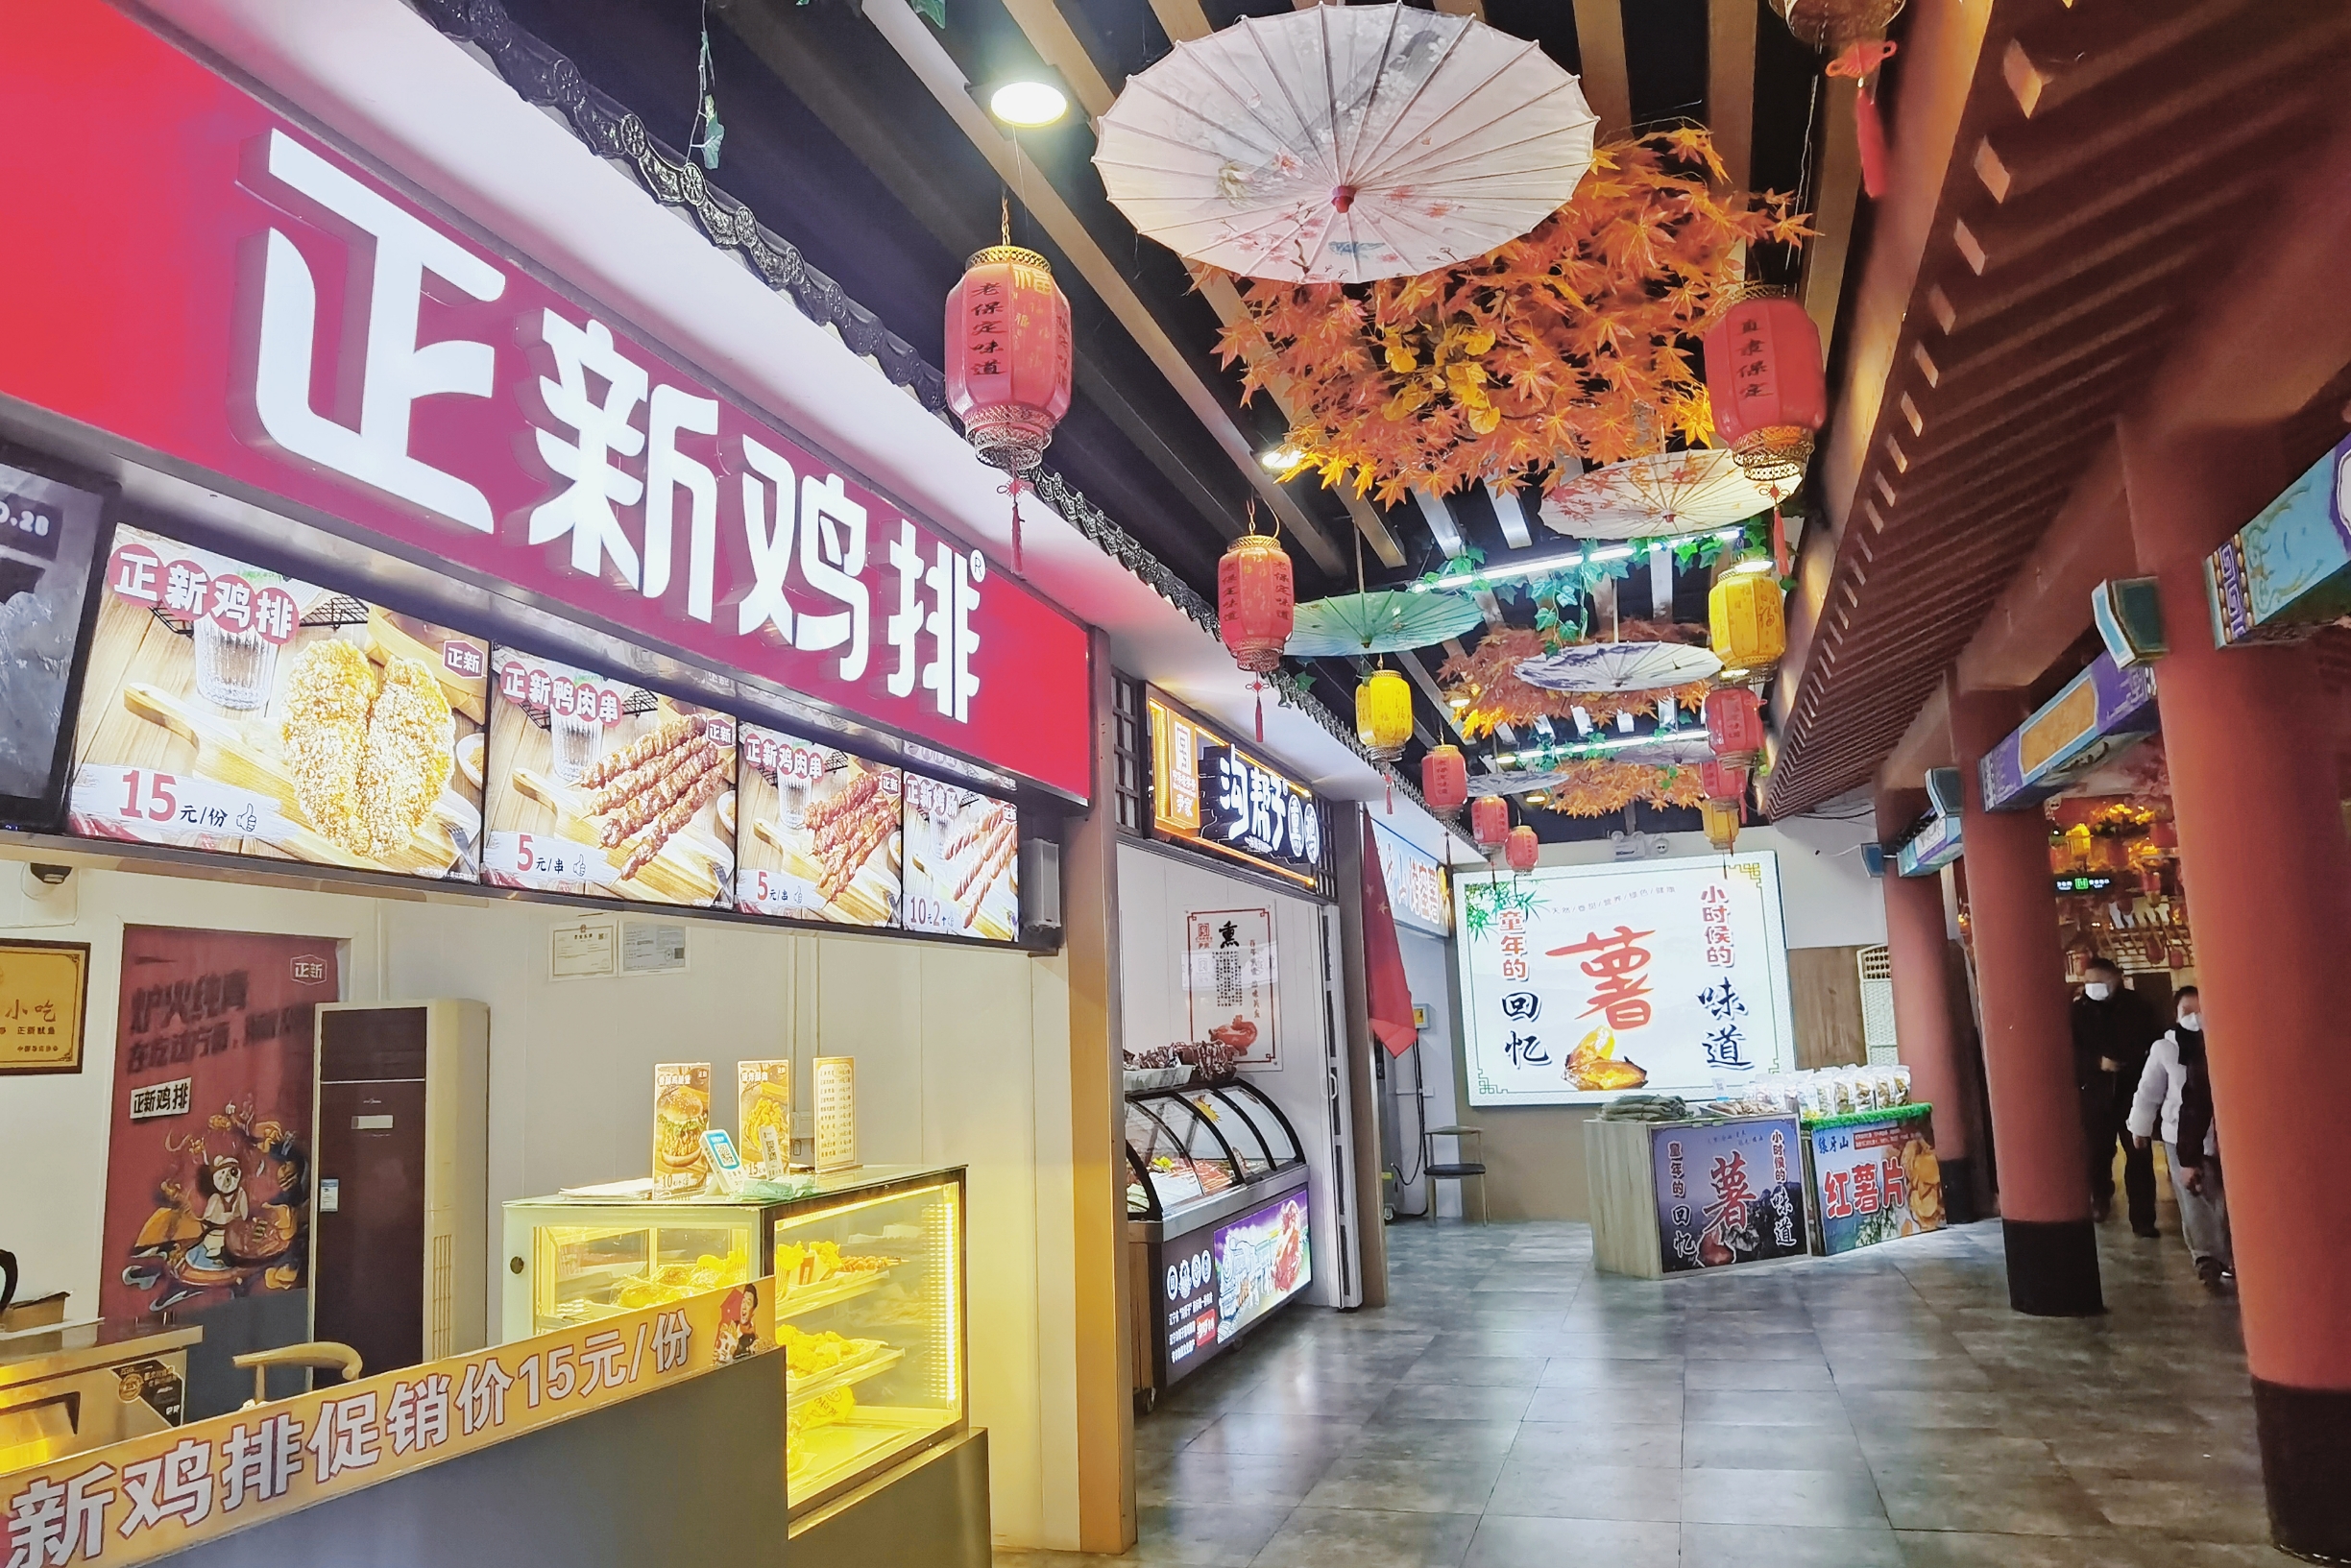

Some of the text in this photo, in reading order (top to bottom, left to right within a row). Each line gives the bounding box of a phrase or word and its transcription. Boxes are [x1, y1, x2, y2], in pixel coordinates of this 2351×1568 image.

[970, 282, 1006, 375] 老保定味道
[256, 128, 981, 724] 正新鸡排
[114, 549, 294, 639] 正新鸡排
[447, 646, 480, 675] 正新
[501, 666, 619, 725] 正新鸭肉串
[709, 724, 732, 743] 正新
[745, 737, 823, 780] 正新鸡肉串
[118, 770, 229, 828] 15元/份
[882, 774, 899, 793] 正新
[906, 778, 958, 816] 正新烤肠
[1220, 743, 1287, 852] 沟帮子
[517, 833, 564, 875] 5元/串
[294, 962, 323, 979] 正新
[1498, 910, 1550, 1066] 童年的回忆
[1544, 925, 1657, 1030] 薯
[1697, 885, 1753, 1067] 小时候的味道
[5, 999, 57, 1023] 小吃
[133, 1083, 189, 1115] 正新鸡排
[1668, 1141, 1697, 1258] 童年的回忆
[1703, 1150, 1757, 1233] 薯
[1771, 1128, 1797, 1246] 小时候的味道
[1824, 1156, 1905, 1219] 红薯片
[4, 1307, 694, 1568] 新鸡排促销价15元/份
